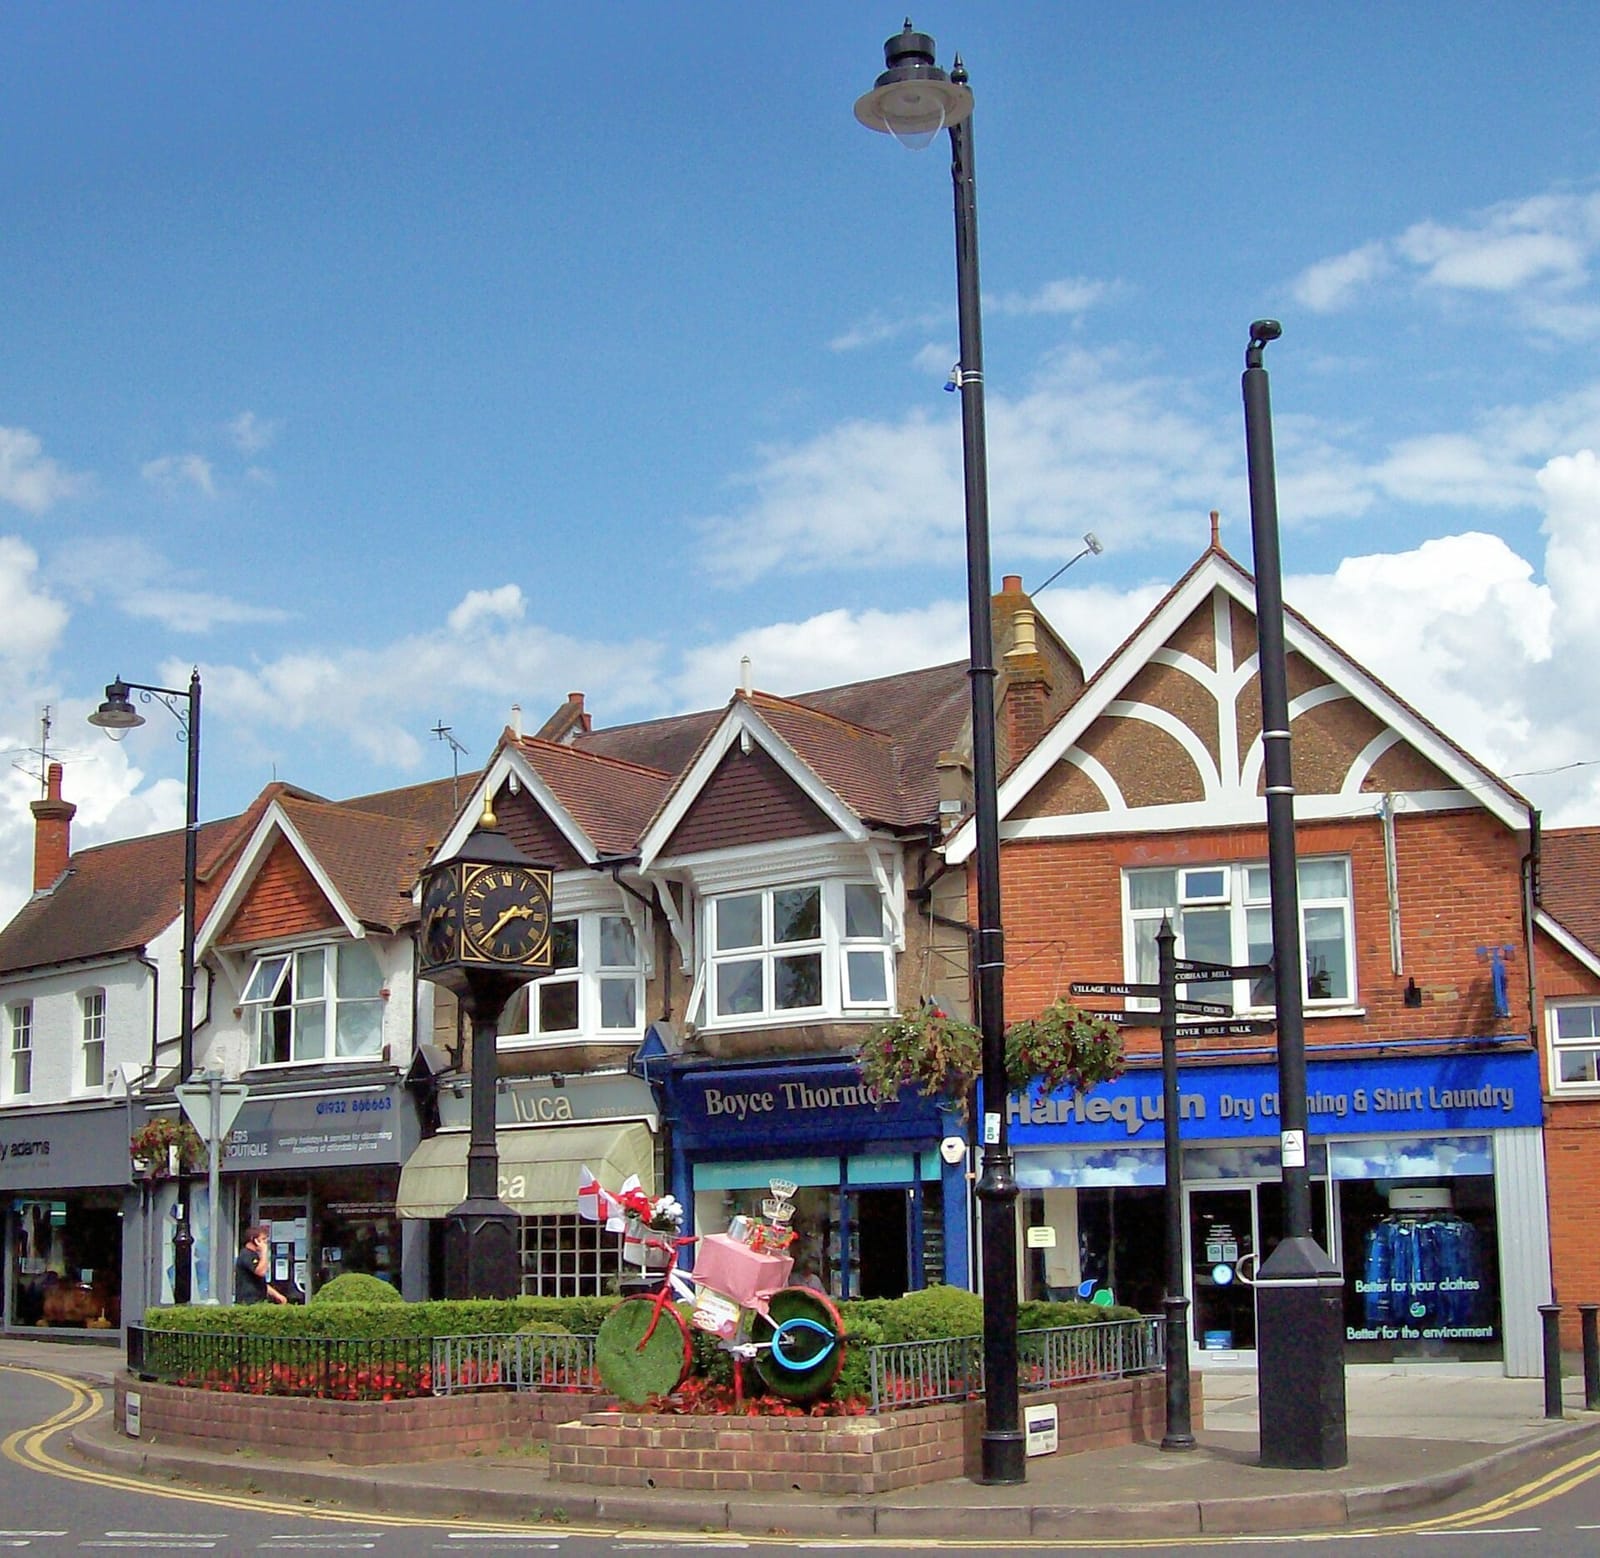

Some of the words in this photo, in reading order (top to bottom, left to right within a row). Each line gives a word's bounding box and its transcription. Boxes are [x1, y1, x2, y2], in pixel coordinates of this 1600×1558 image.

[1175, 972, 1208, 980] COBHAM
[1073, 985, 1105, 993] VILLAGE
[1110, 986, 1130, 994] HALL
[1176, 1028, 1200, 1036] RIVER
[1229, 1025, 1251, 1033] WALK
[512, 1091, 573, 1123] luca
[704, 1089, 774, 1121] Boyce
[779, 1083, 900, 1111] Thornto
[1006, 1092, 1206, 1134] Harlequn
[1220, 1094, 1255, 1121] Dry
[1261, 1090, 1348, 1117] Clning
[1353, 1089, 1368, 1112] &
[1373, 1086, 1424, 1112] Shirt
[1429, 1084, 1514, 1110] Laundry
[1355, 1278, 1388, 1293] Better
[1391, 1278, 1407, 1292] for
[1409, 1281, 1436, 1296] your
[1439, 1276, 1480, 1291] clothes
[1346, 1326, 1379, 1340] Better
[1381, 1325, 1399, 1339] for
[1401, 1325, 1420, 1339] the
[1422, 1325, 1493, 1338] environment
